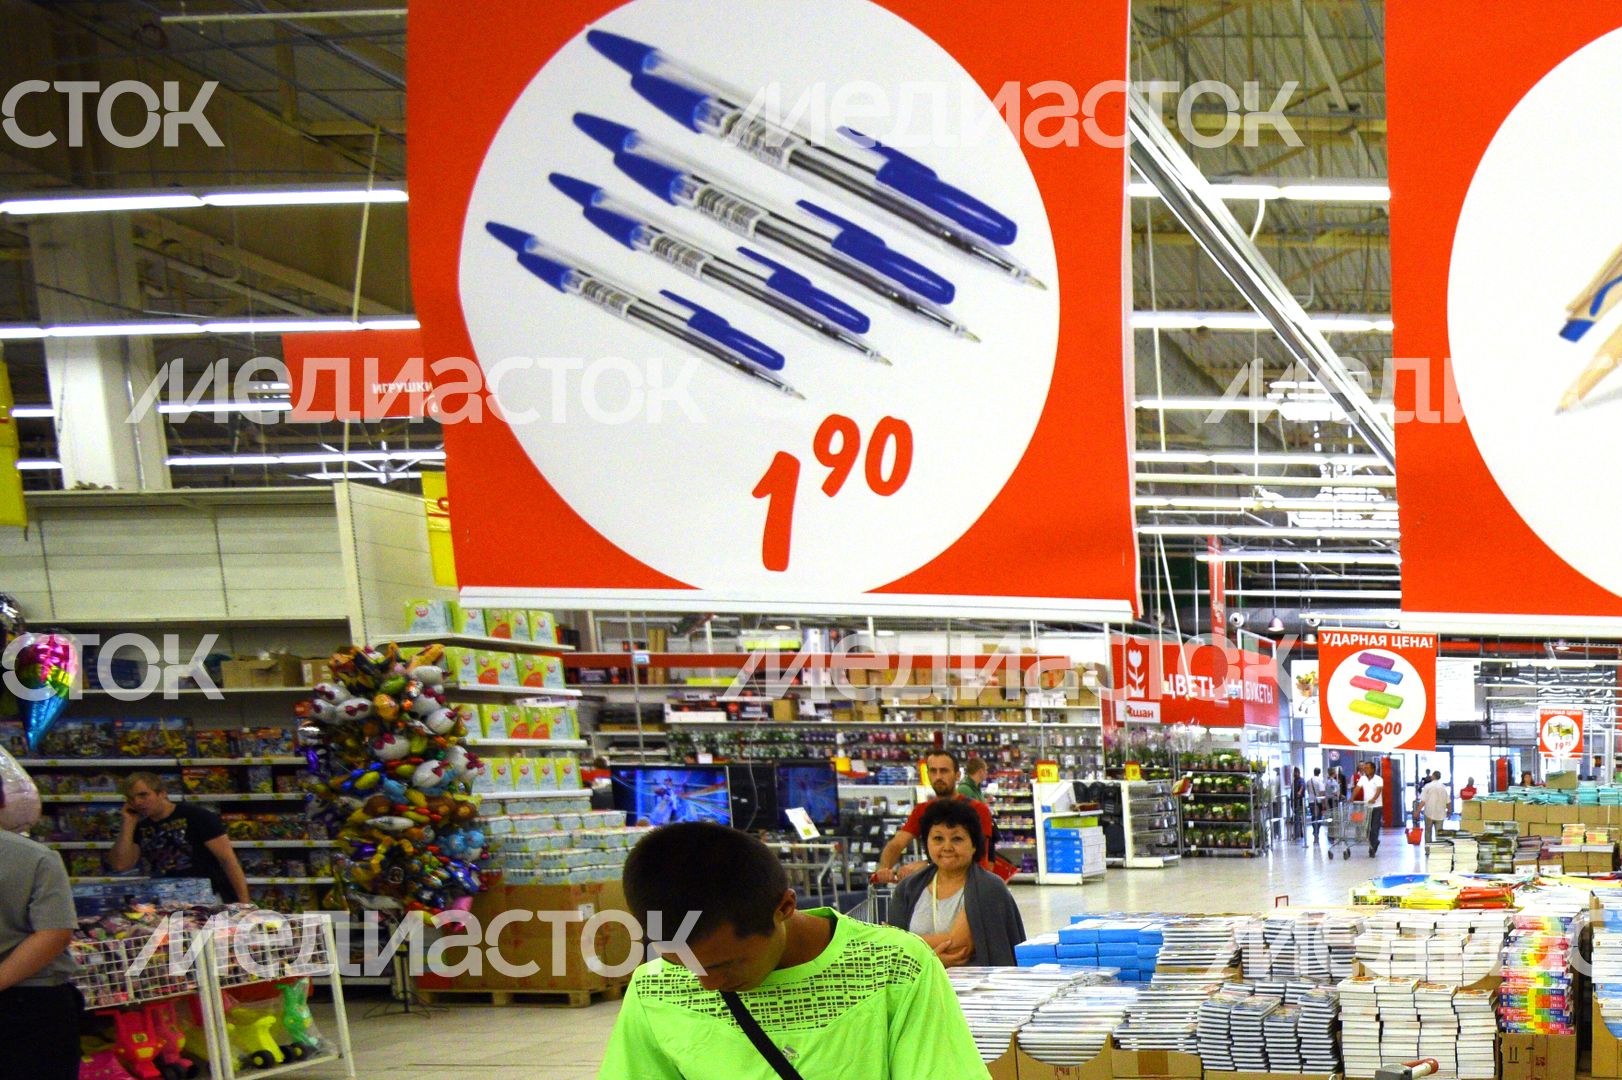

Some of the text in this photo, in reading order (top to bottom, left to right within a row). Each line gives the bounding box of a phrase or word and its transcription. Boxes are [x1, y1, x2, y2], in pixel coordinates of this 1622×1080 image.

[752, 414, 914, 572] 1 90
[1322, 633, 1433, 649] УДАРНАЯ ЦЕНА!
[1358, 722, 1402, 743] 28 00
